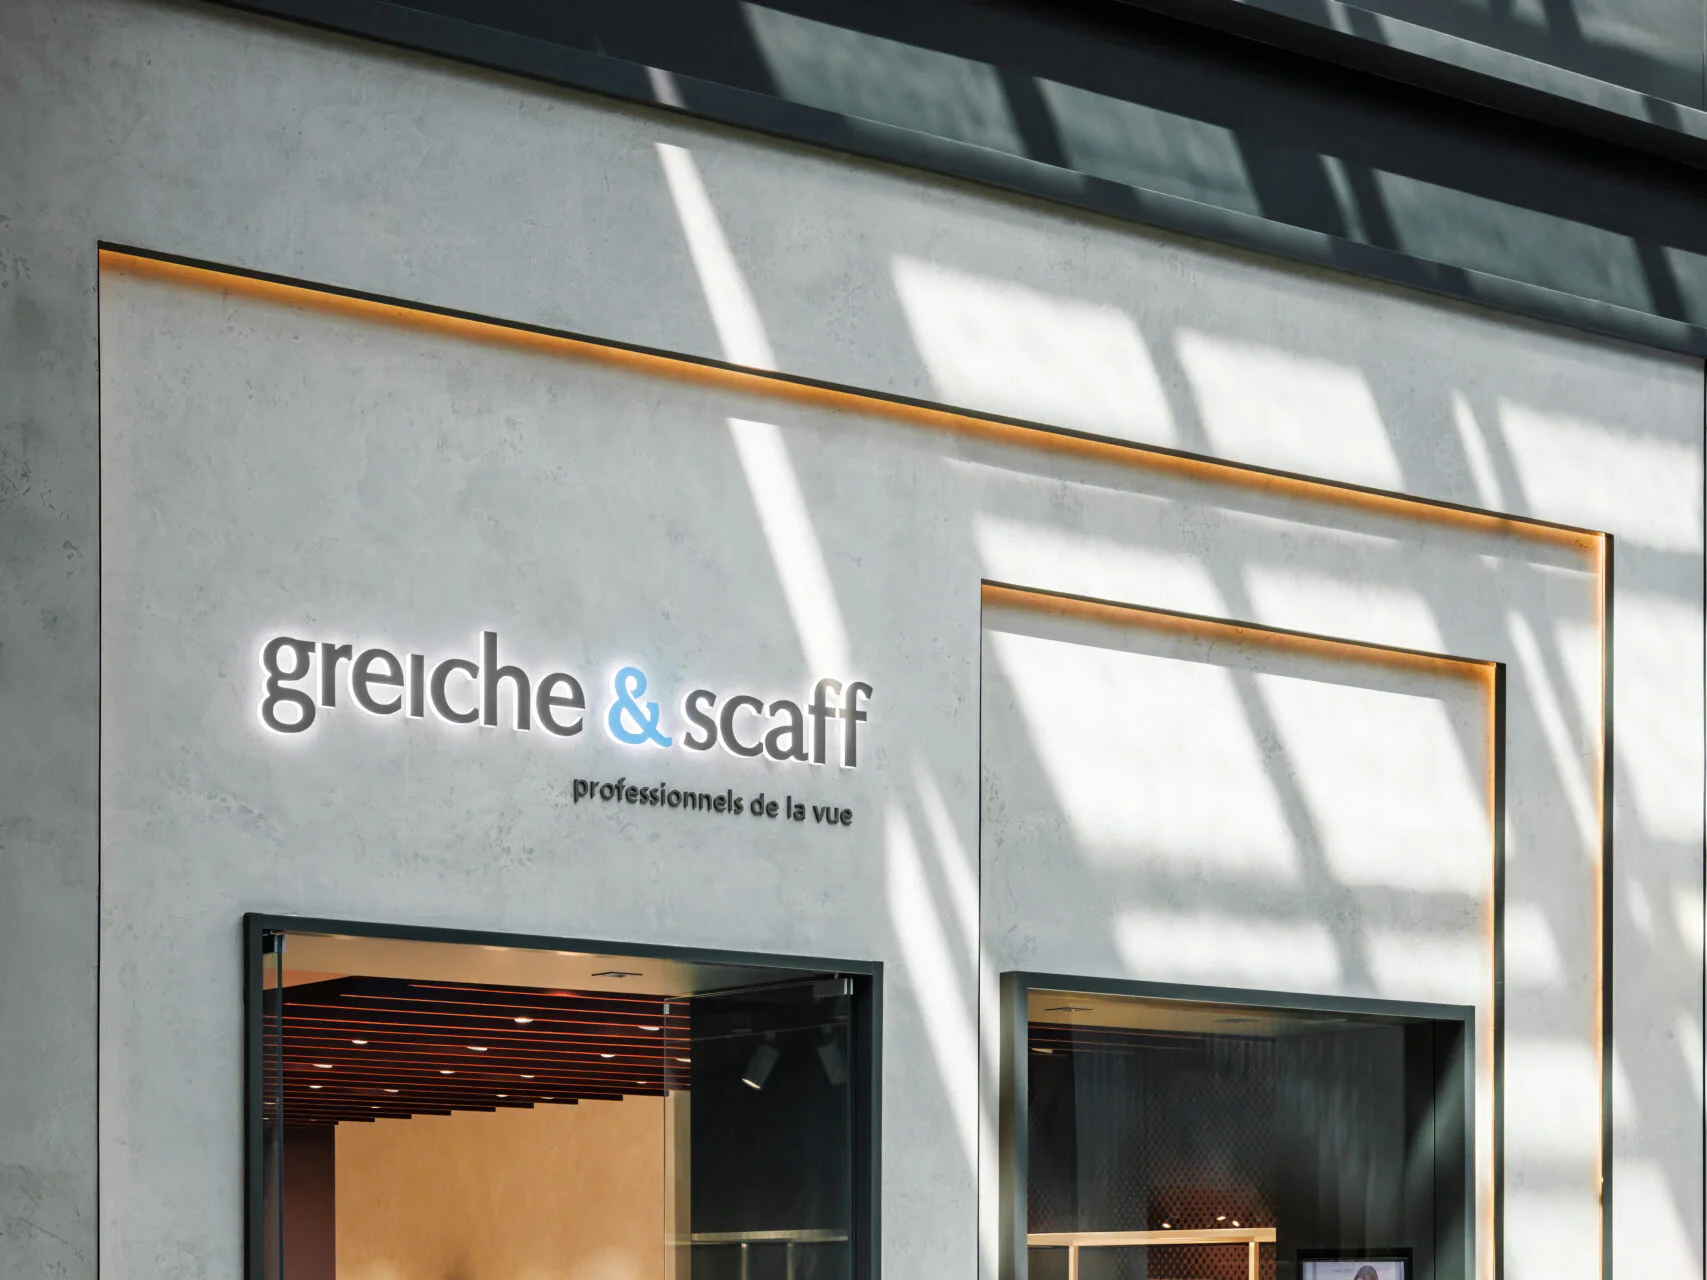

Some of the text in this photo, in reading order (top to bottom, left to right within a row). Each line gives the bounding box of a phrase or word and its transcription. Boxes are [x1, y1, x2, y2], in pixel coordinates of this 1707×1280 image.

[260, 631, 874, 769] greiche & scaff
[573, 777, 853, 826] professionnels de la vue
